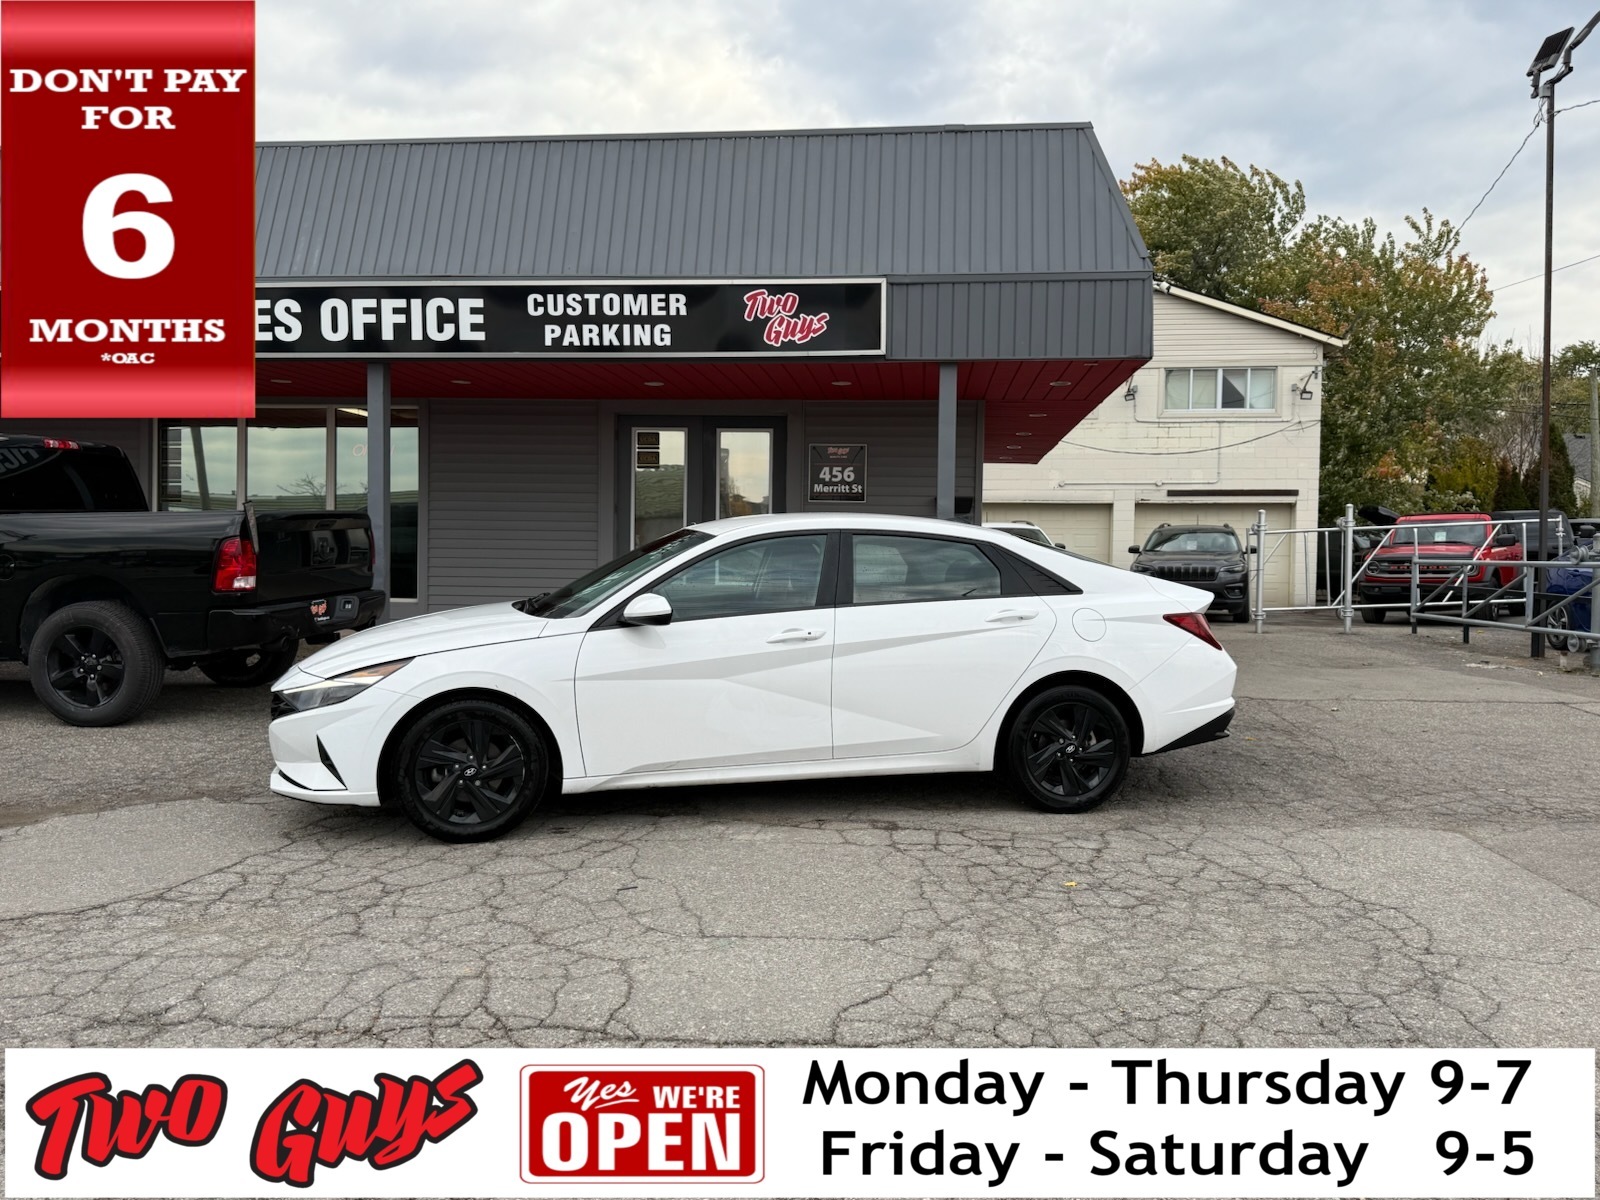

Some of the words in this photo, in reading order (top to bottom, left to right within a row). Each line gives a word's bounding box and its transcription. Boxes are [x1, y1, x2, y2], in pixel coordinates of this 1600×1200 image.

[527, 292, 688, 317] CUSTOMER
[743, 288, 799, 321] Two
[320, 297, 486, 342] OFFICE
[763, 313, 829, 347] Guys
[544, 323, 672, 347] PARKING
[819, 466, 855, 482] 456
[813, 483, 850, 493] Merritt
[851, 483, 863, 493] St
